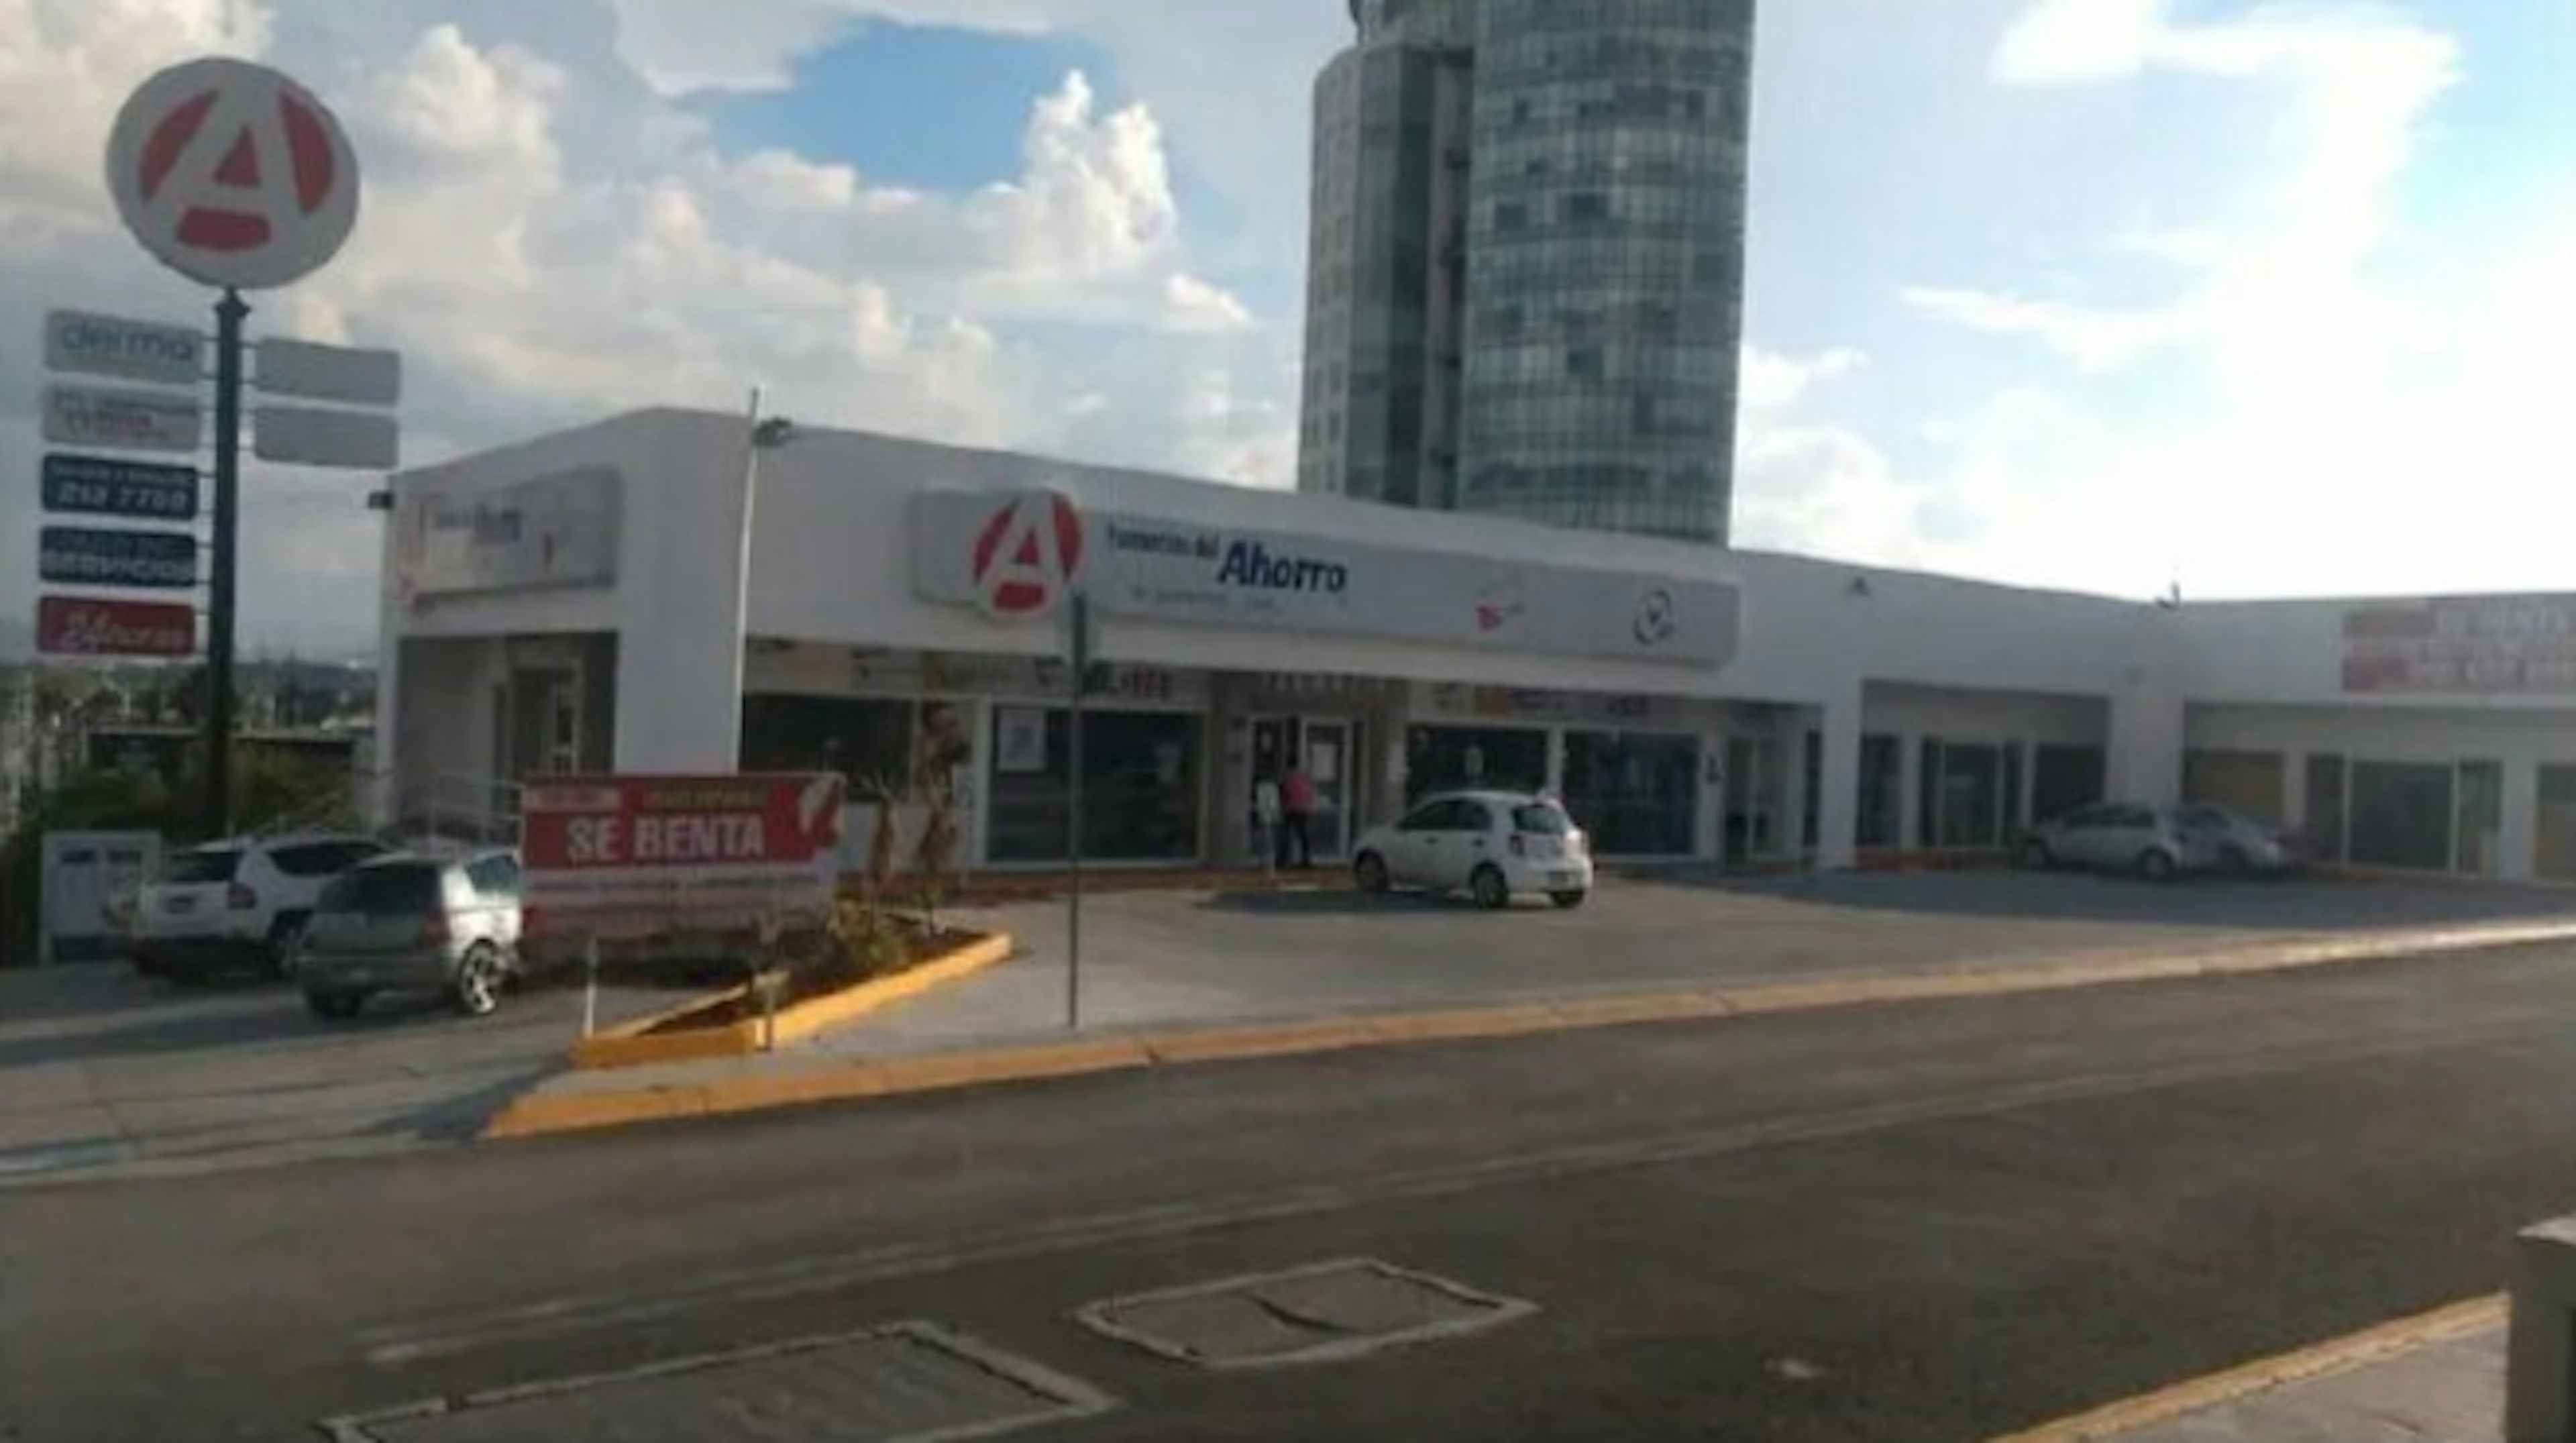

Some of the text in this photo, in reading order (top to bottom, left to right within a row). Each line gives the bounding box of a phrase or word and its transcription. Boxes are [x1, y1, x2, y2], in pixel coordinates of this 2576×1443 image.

[62, 320, 193, 360] derma
[1218, 538, 1348, 592] Ahorro
[566, 816, 619, 862] SE
